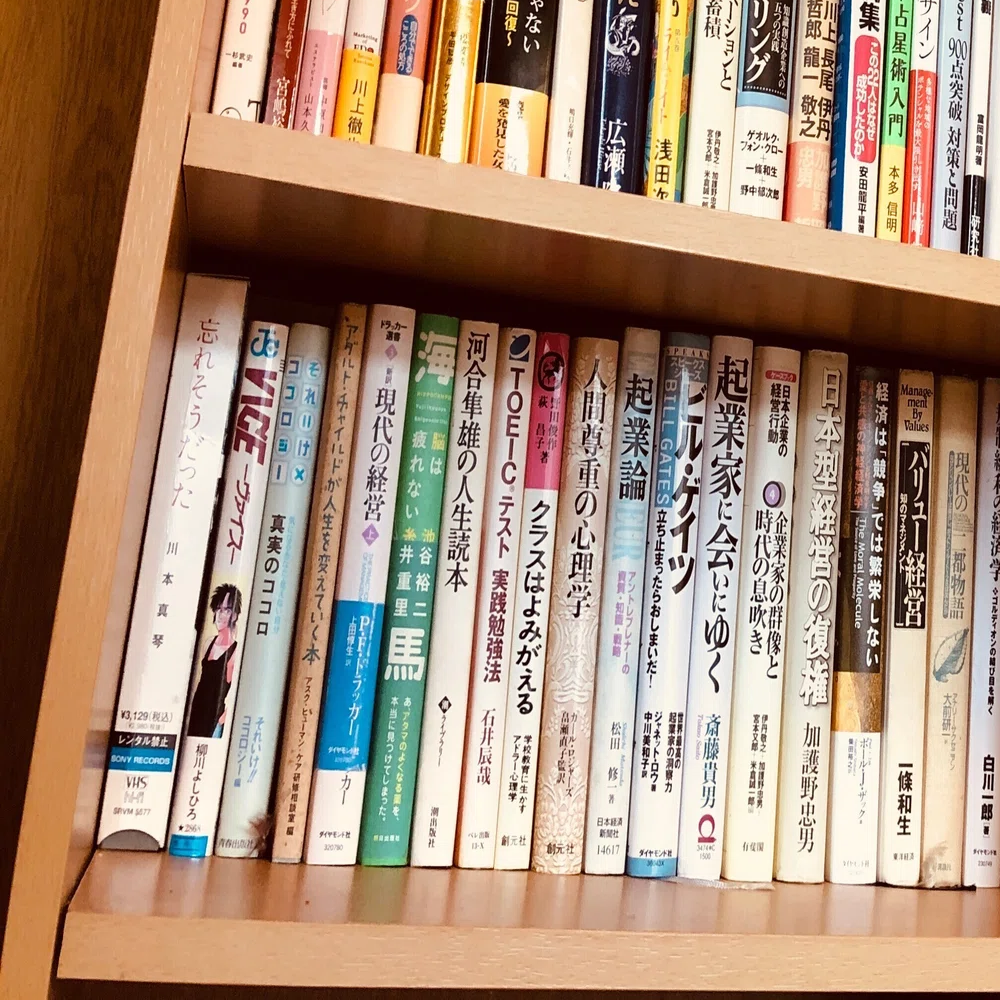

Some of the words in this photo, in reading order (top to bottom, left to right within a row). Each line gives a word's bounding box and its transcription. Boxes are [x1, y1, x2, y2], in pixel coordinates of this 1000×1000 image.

[821, 0, 838, 44] 川上
[802, 47, 820, 81] 龍一
[818, 48, 835, 93] 長尾
[866, 42, 879, 142] この22人はなぜ
[946, 37, 968, 123] 900点突破
[798, 94, 817, 139] 敬之
[815, 95, 833, 142] 伊丹
[854, 74, 867, 157] 成功したのか
[887, 165, 900, 195] 本多
[942, 126, 962, 232] 対策と問題
[886, 201, 898, 233] 信明
[380, 320, 408, 333] ドラッカー
[415, 330, 459, 386] 海
[171, 317, 220, 510] 忘れそうだった
[232, 367, 278, 467] VICE
[618, 372, 654, 502] 起業論
[661, 380, 677, 433] BILL
[767, 382, 782, 445] 経営行動
[777, 384, 792, 458] 日本企業の
[904, 420, 930, 433] Values
[912, 408, 923, 422] By
[363, 387, 397, 523] 現代の経営
[405, 431, 428, 520] 疲れない
[428, 431, 445, 476] 脳は
[444, 330, 491, 593] 河合隼雄の人生読本
[566, 357, 608, 619] 人間尊重の心理学
[657, 438, 673, 506] GATES
[668, 382, 707, 596] ビル・ゲイツ
[367, 530, 375, 540] 上
[704, 354, 750, 694] 起業家に会いにゆく
[799, 365, 843, 707] 日本型経営の復権
[866, 380, 890, 668] 経済は「競争」では繁栄しない
[904, 444, 930, 628] バリュー経営
[256, 514, 286, 637] 真実のココロ
[393, 527, 417, 618] 糸井重里
[412, 527, 436, 617] 池谷裕二
[515, 500, 551, 715] クラスはよみがえる
[645, 509, 667, 690] 立ち止まったらおしまいだ!
[748, 509, 773, 656] 時代の息吹き
[766, 512, 789, 680] 企業家の群像と
[384, 626, 426, 682] 馬
[111, 754, 132, 764] SONY
[133, 755, 170, 765] RECORDS
[118, 734, 169, 748] レンタル禁止
[507, 734, 523, 802] アドラー心理学
[518, 734, 532, 814] 学校教育に生かす
[126, 775, 148, 789] VHS
[186, 743, 208, 821] 柳川よしひろ
[797, 721, 821, 854] 加護野忠男
[980, 754, 995, 821] 白川一郎
[501, 835, 527, 847] 創元社
[596, 817, 623, 828] 日本経済
[599, 828, 619, 839] 新聞社
[638, 848, 673, 858] ダイヤモンド社
